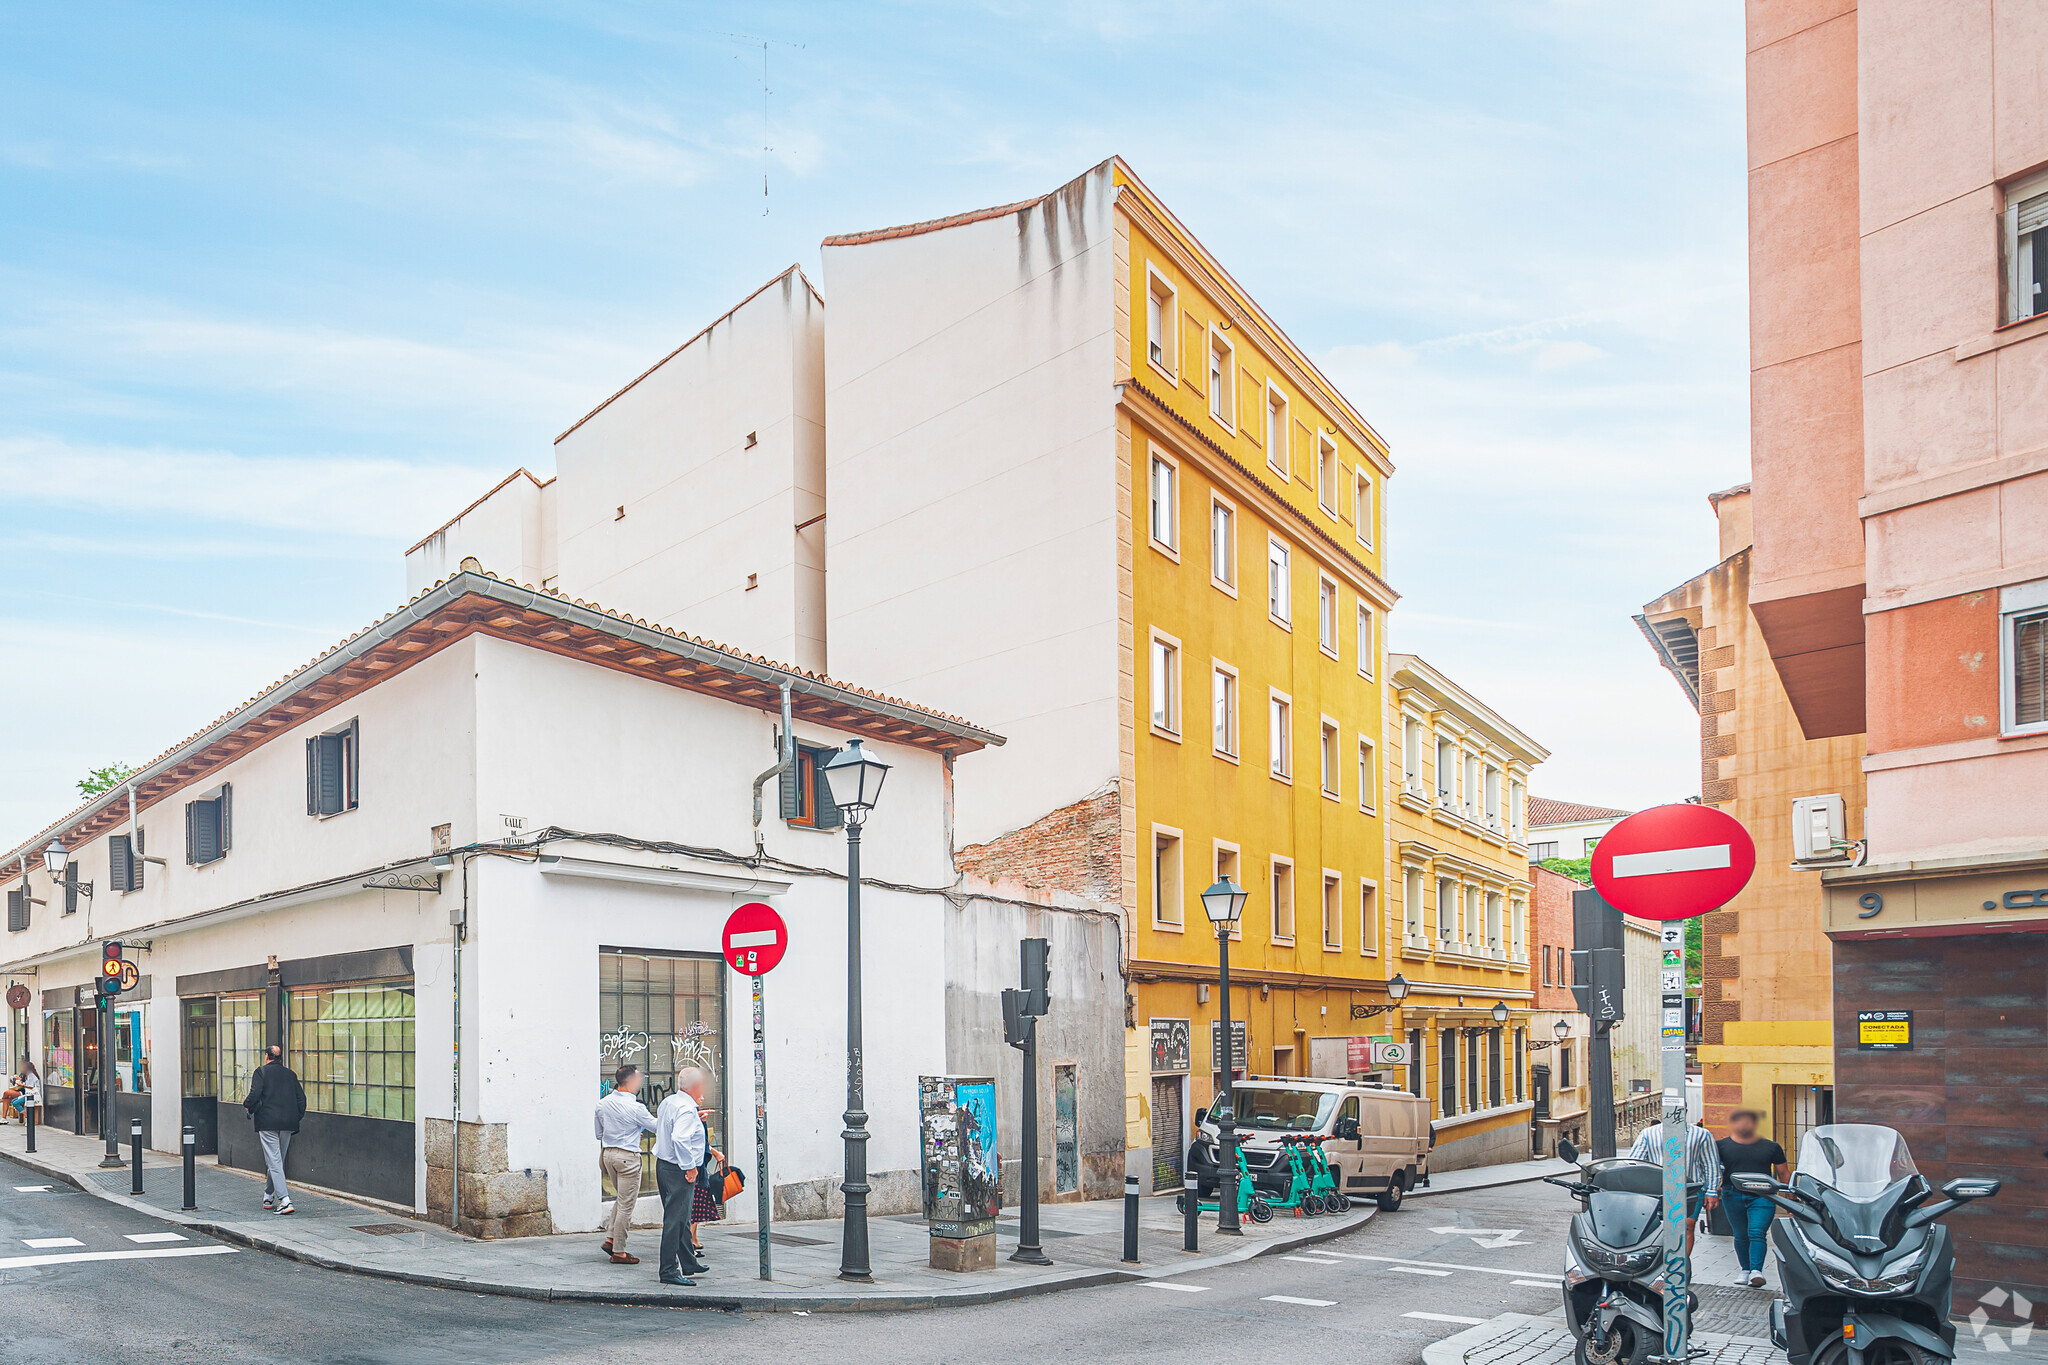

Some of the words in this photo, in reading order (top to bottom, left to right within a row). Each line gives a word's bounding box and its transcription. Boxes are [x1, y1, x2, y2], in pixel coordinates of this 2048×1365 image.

[504, 817, 522, 829] CALLE
[1858, 892, 1883, 919] 9
[1663, 978, 1681, 990] 54
